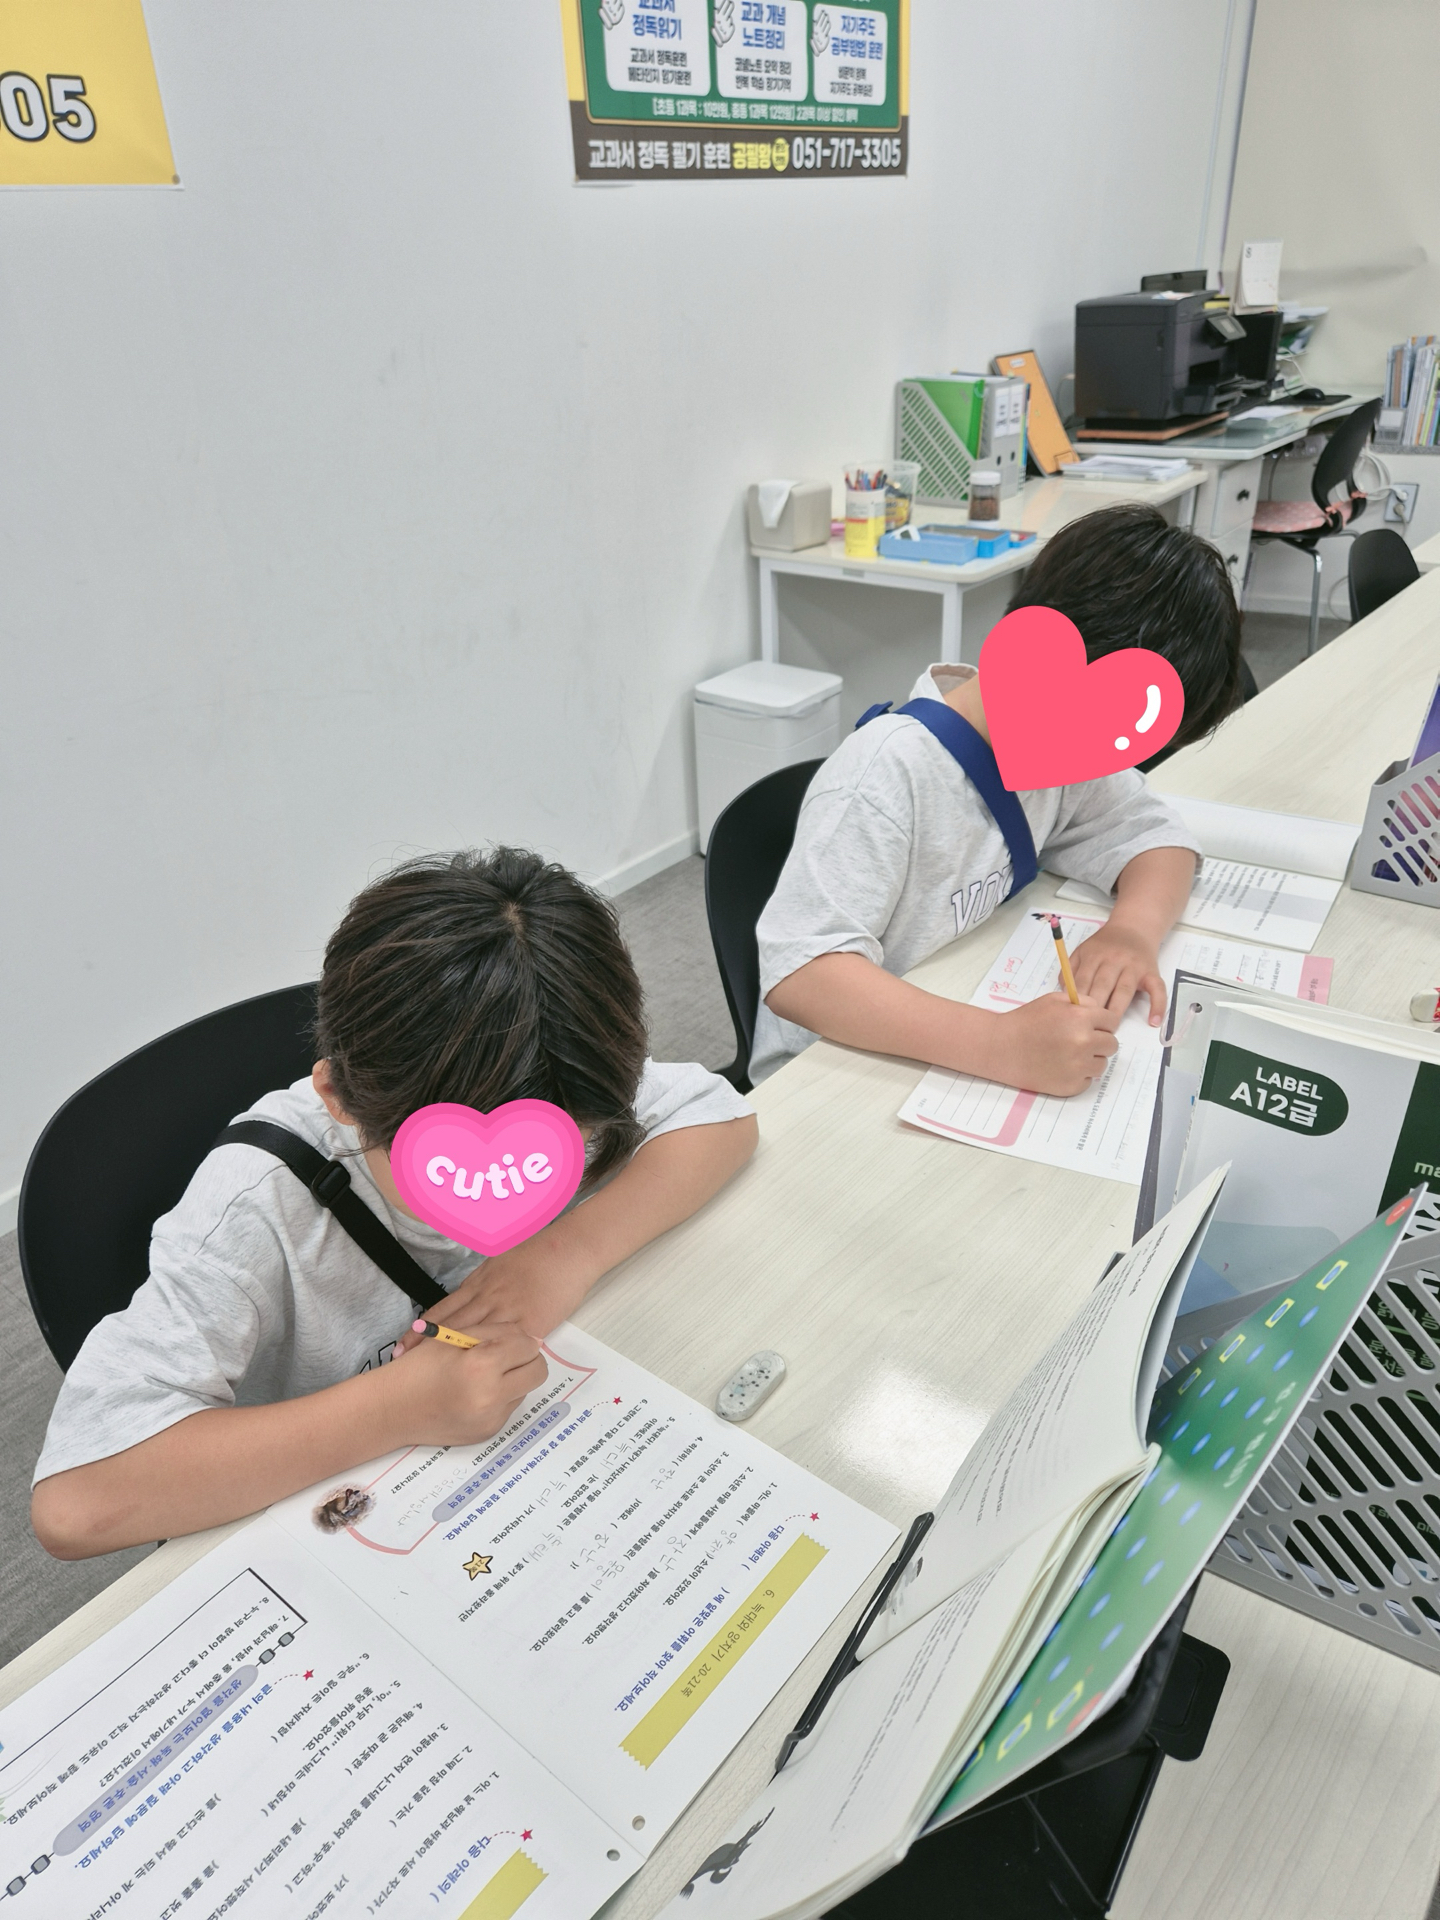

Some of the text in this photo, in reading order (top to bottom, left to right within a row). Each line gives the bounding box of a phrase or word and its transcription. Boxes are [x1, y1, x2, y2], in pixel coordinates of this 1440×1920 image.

[632, 14, 682, 40] 정독읽기
[741, 2, 786, 26] 교과 개념
[743, 27, 785, 50] 노트정리
[0, 71, 97, 143] 05
[588, 140, 635, 169] 교과서
[638, 140, 669, 169] 정독
[672, 142, 700, 169] 필기
[703, 142, 731, 169] 훈련
[792, 137, 901, 169] 051-717-3305
[1230, 1081, 1318, 1128] A12급
[1255, 1067, 1323, 1101] LABEL
[471, 1381, 566, 1466] 소년이 장난을 이유가 무엇인가요?
[510, 1427, 540, 1452] 열어보는
[537, 1409, 560, 1429] 생각을
[441, 1408, 593, 1541] 글의 내용을 생각해서 아래의 질문에 답하세요.
[488, 1404, 642, 1544] 그런데 다음 날에는 정말로 나타났어요.
[560, 1417, 658, 1508] 이번에도 없었어요.
[702, 1457, 722, 1477] 소년이
[446, 1493, 466, 1509] 영역
[662, 1499, 683, 1520] 외치자
[679, 1481, 699, 1502] 소리로
[457, 1424, 670, 1623] "늑대다! 늑대가 나타났다!" 마을 사람들은 쫓기 위해 올라왔지만
[649, 1518, 666, 1533] 마을
[581, 1472, 747, 1645] 소년은 마을 사람들에게 생각했어요.
[662, 1489, 772, 1606] 어느 마을에 소년이 있었어요.
[564, 1602, 583, 1619] 들고
[614, 1524, 785, 1712] 다음 아래의 알맞은 어휘를 찾아 적어보세요.
[528, 1616, 569, 1652] 달려왔어요.
[680, 1603, 765, 1698] 늑대와 양치기 20-21쪽
[212, 1678, 242, 1707] 생각을
[172, 1706, 213, 1744] 열어보는
[302, 1685, 374, 1751] 풍덩 뛰어들었어요.
[74, 1683, 273, 1869] 글의 내용을 생각하고 아래 질문에 답하세요.
[394, 1752, 464, 1820] 그때 마침 길을 가는
[77, 1809, 102, 1833] 영역
[291, 1731, 439, 1886] 바람이 먼저 나그네를 향하여 '후우'하고
[372, 1779, 491, 1908] 어느 해님과 바람이 서로 자기가
[437, 1836, 491, 1895] 다음 아래의
